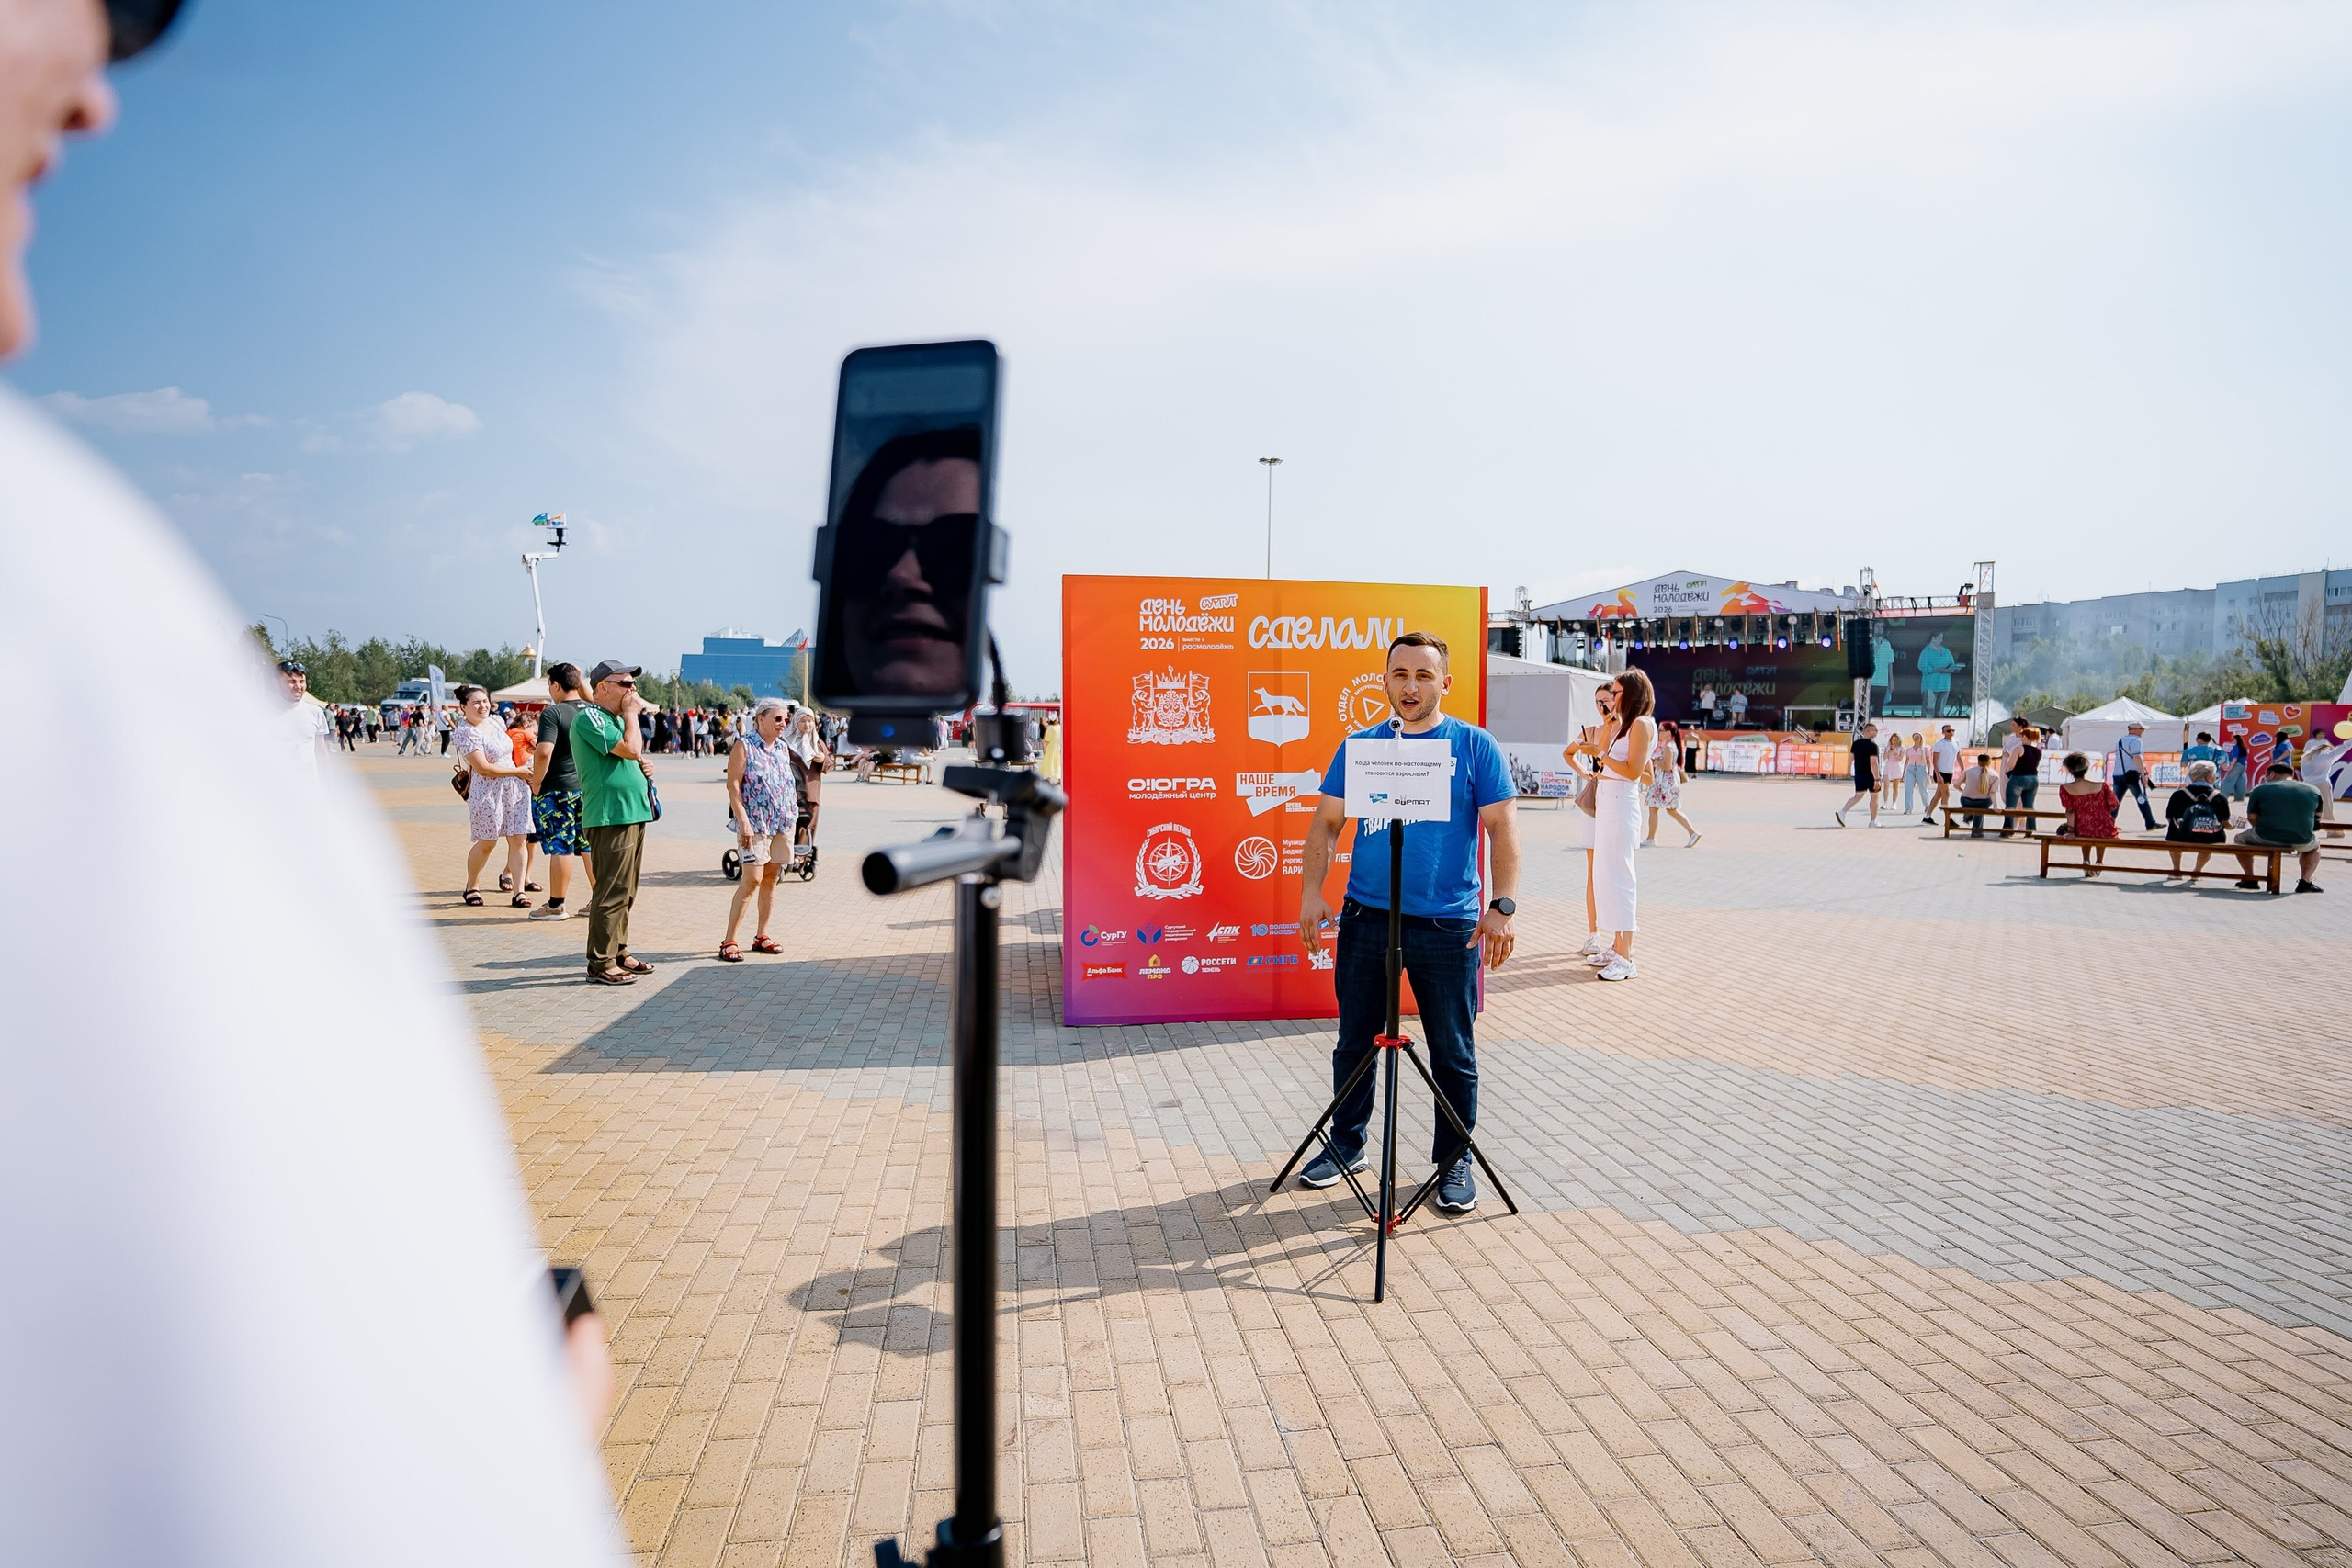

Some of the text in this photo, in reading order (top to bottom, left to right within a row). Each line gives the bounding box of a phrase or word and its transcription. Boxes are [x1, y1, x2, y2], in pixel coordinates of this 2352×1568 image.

[1139, 599, 1186, 615] ДЕНЬ
[1139, 613, 1234, 632] МОЛОДЁЖИ
[1140, 637, 1175, 650] 2026
[1338, 673, 1385, 722] ОТДЕЛ МОЛО
[1240, 774, 1274, 784] НАШЕ
[1129, 791, 1187, 799] молодёжный
[1255, 786, 1296, 797] ВРЕМЯ
[1217, 925, 1240, 935] СПК
[1101, 931, 1127, 941] СурГУ
[1265, 954, 1298, 965] СНГБ
